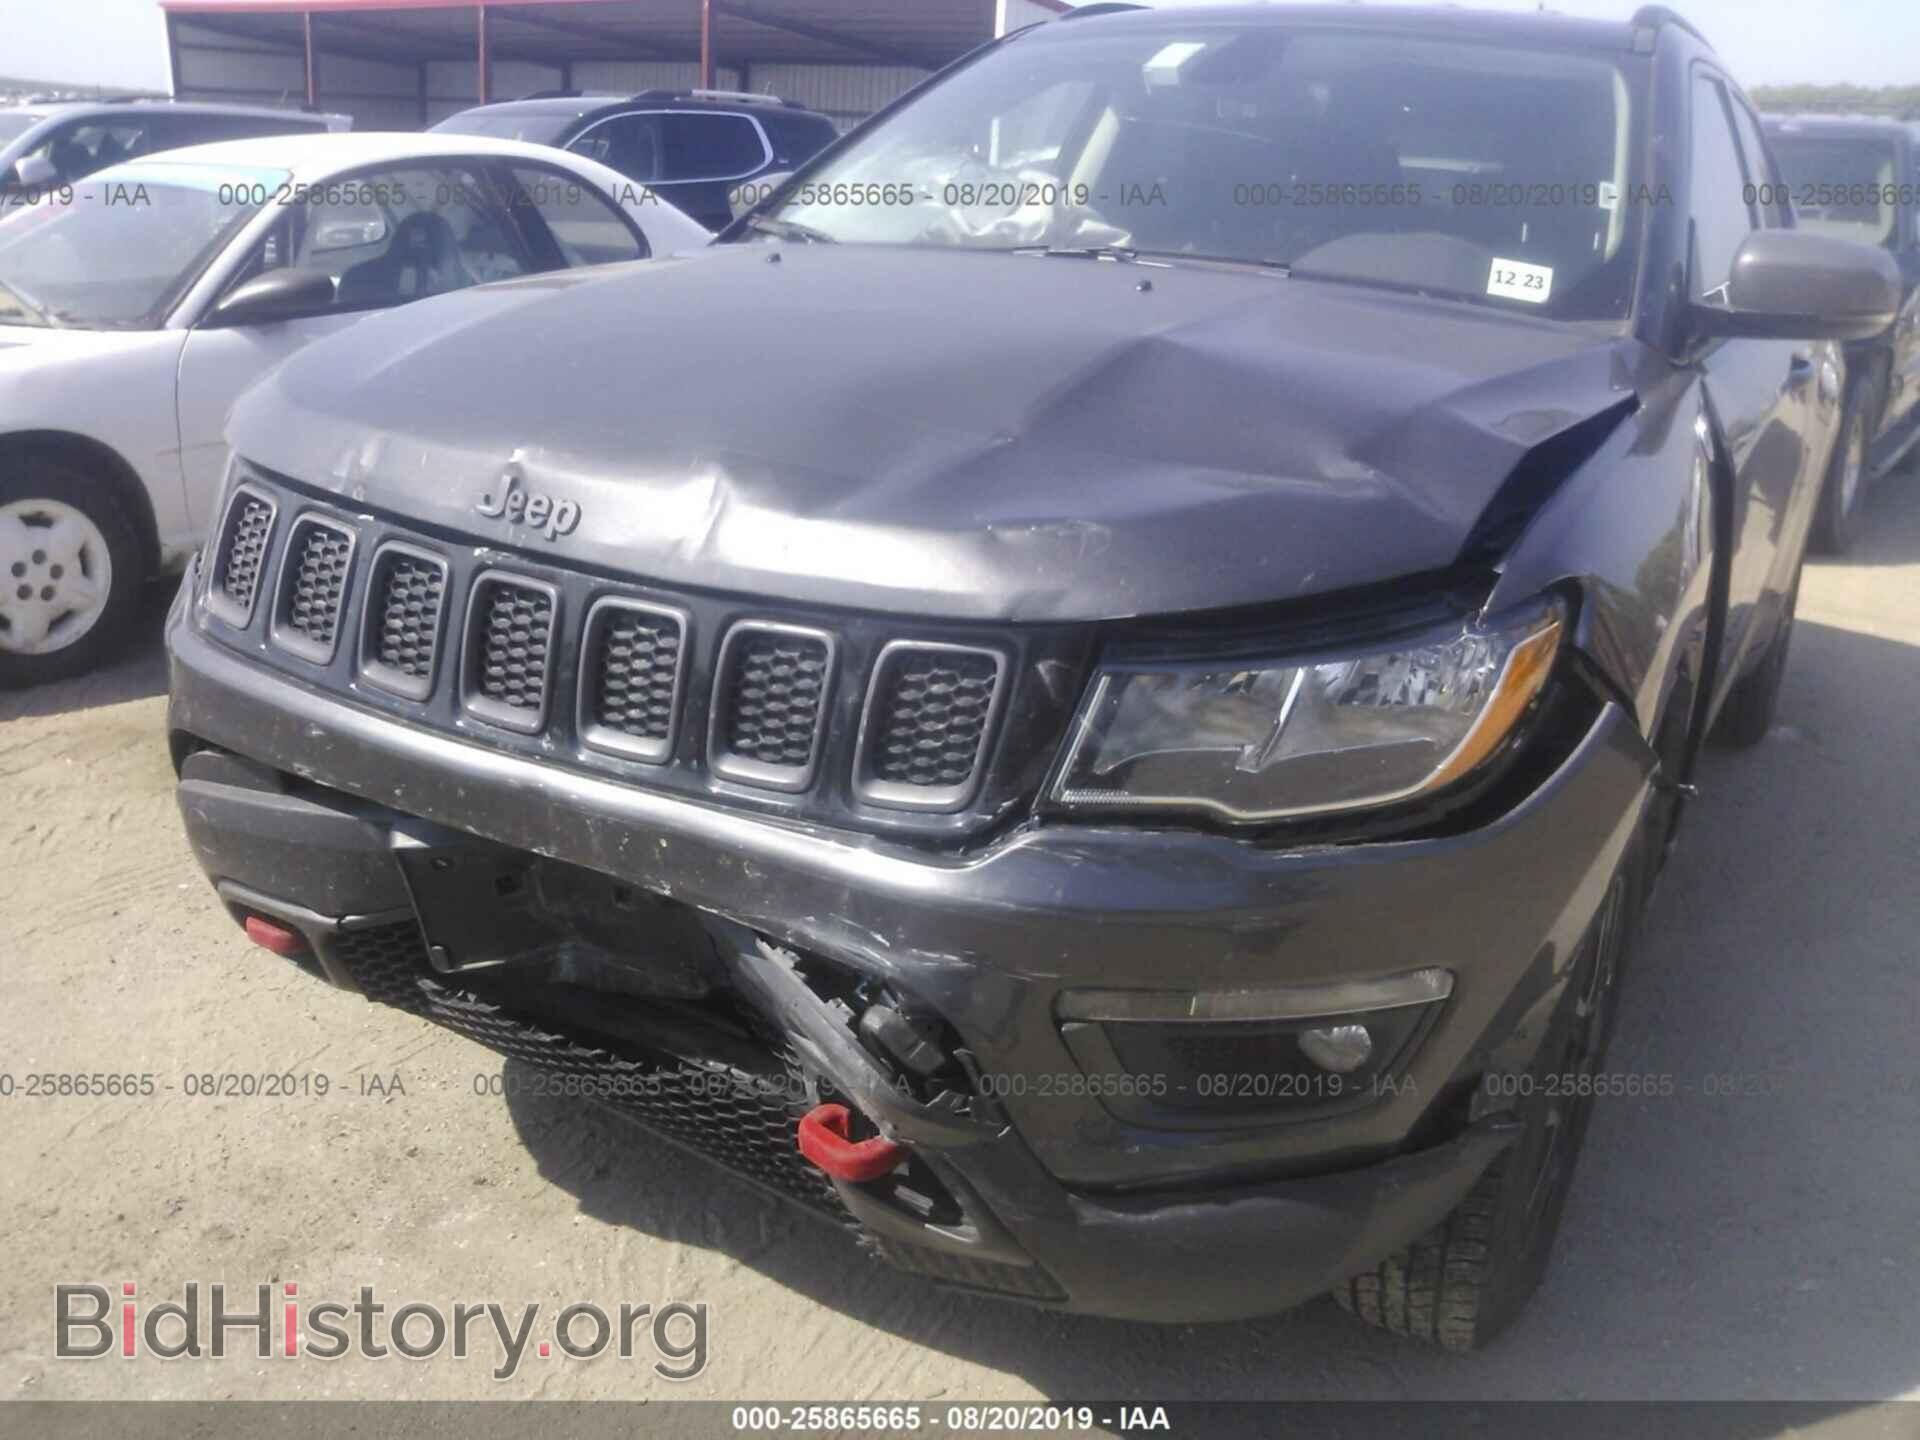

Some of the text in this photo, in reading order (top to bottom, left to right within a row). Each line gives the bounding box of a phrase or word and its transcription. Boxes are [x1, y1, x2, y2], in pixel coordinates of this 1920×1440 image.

[1495, 269, 1544, 290] 12 23
[476, 474, 582, 542] Jeep
